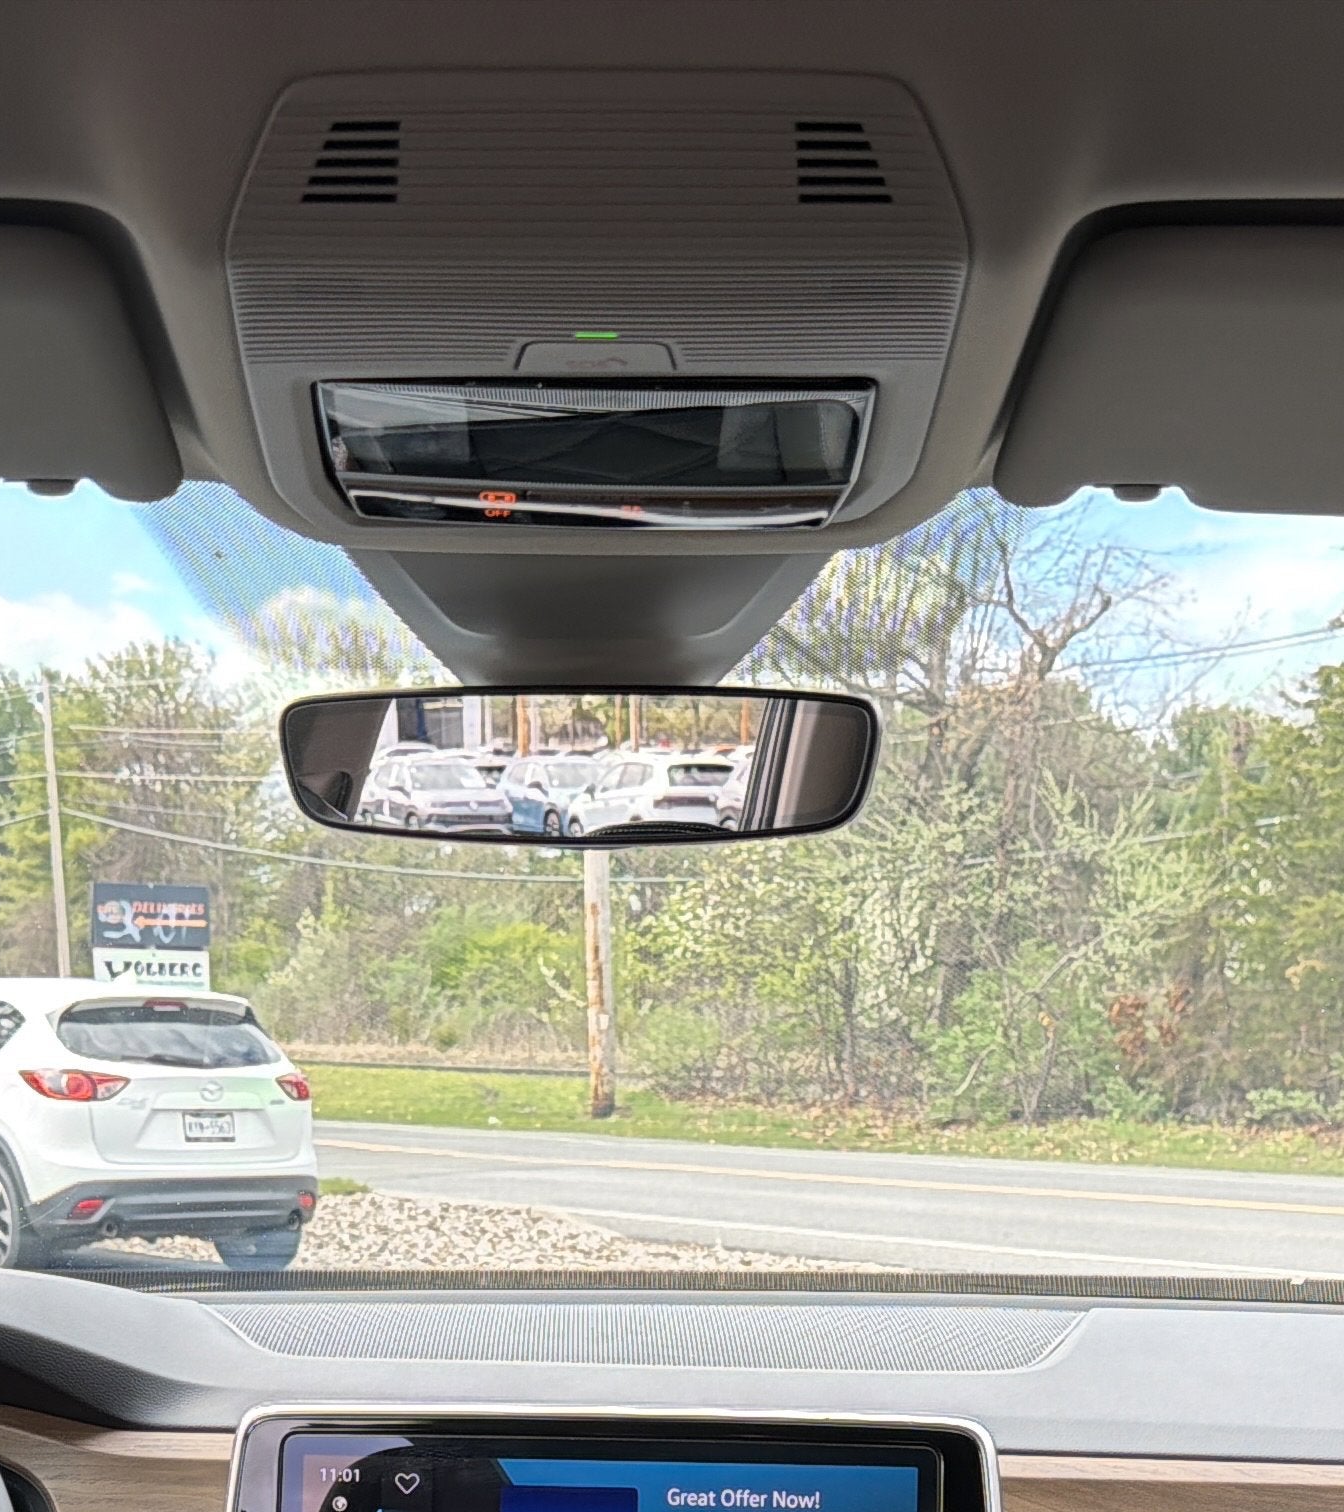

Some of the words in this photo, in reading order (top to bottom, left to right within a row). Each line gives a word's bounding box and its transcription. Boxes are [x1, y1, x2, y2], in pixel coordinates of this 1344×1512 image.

[484, 509, 512, 518] OFF
[320, 1467, 361, 1483] 11:01
[667, 1487, 717, 1507] Great
[720, 1488, 768, 1508] Offer
[772, 1490, 821, 1510] Now!
